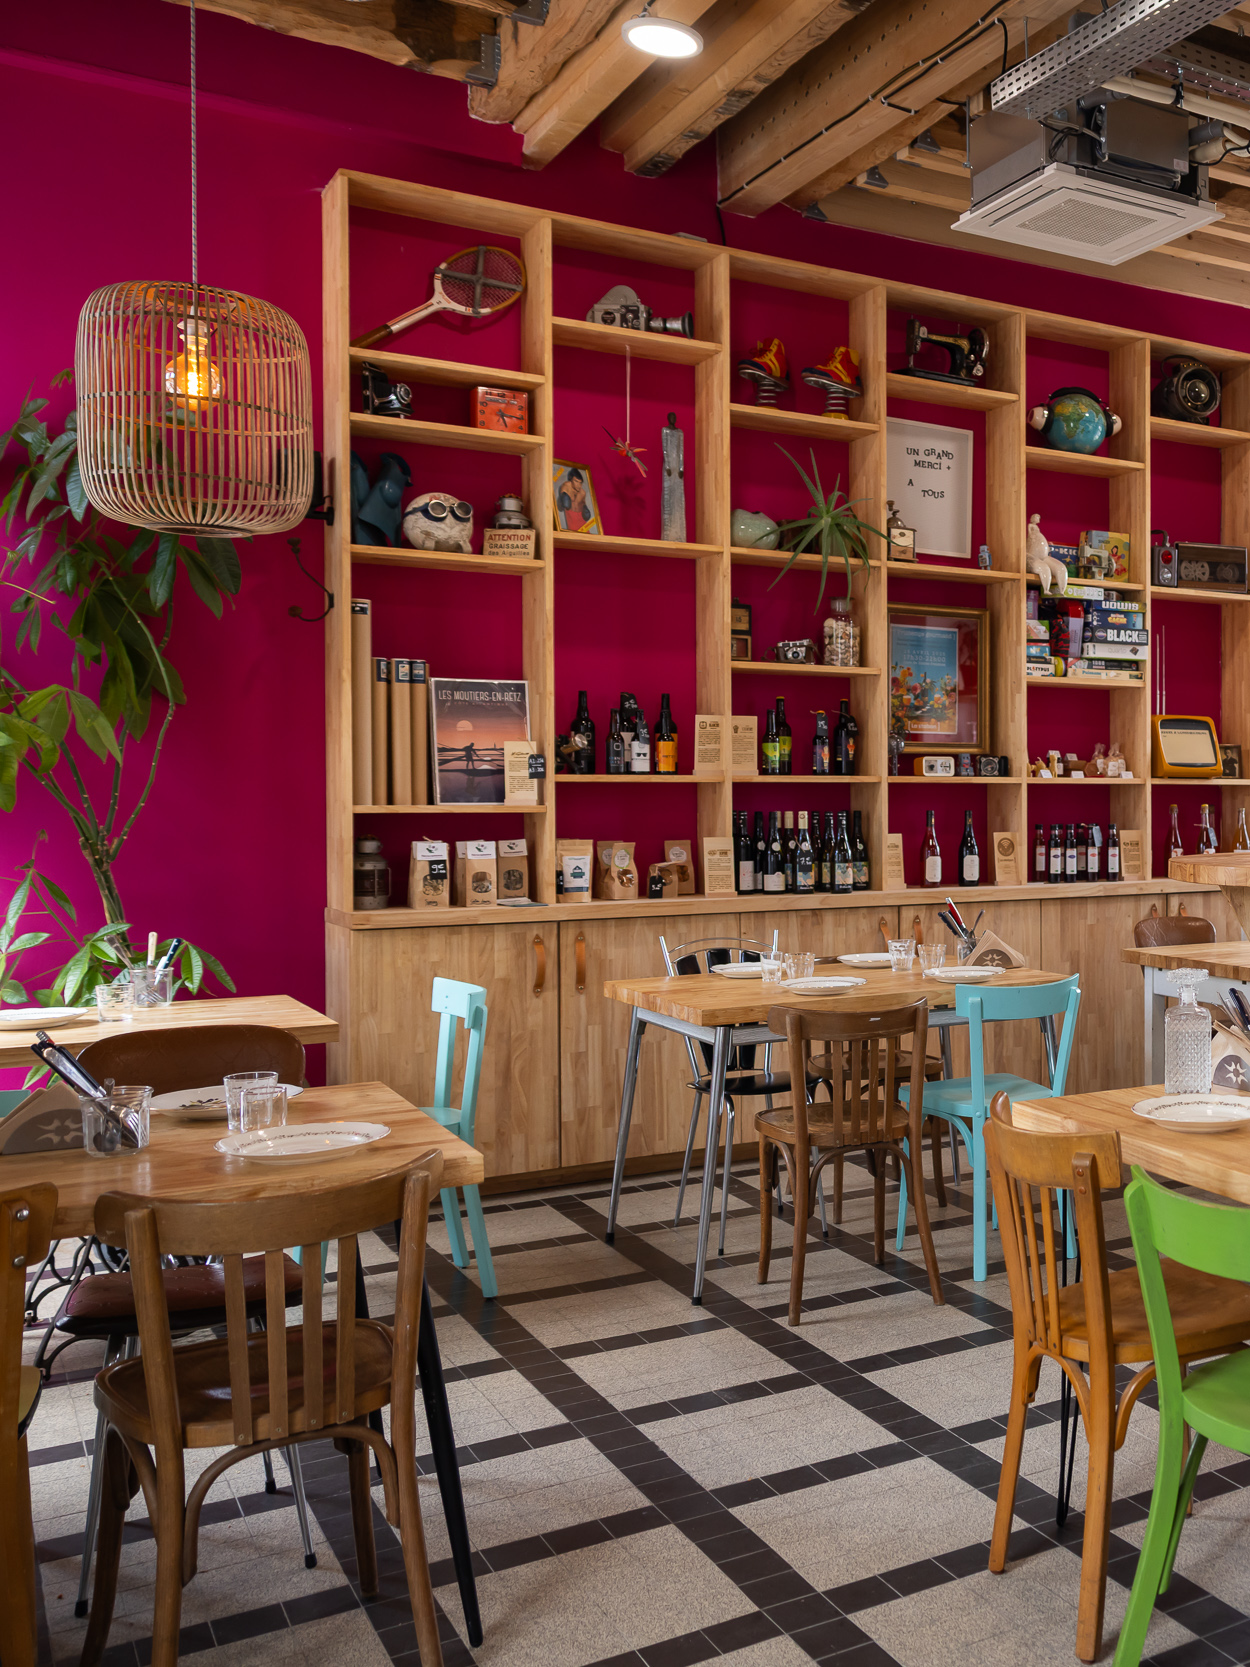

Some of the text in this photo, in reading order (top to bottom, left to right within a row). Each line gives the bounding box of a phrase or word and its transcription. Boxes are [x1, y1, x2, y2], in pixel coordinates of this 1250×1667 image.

[906, 447, 954, 460] UN GRAND
[907, 478, 914, 486] A
[921, 489, 945, 499] TOUS
[488, 533, 531, 541] ATTENTION
[1107, 629, 1139, 643] BLACK
[438, 690, 522, 702] LES MOUTIERS-EN-RETZ
